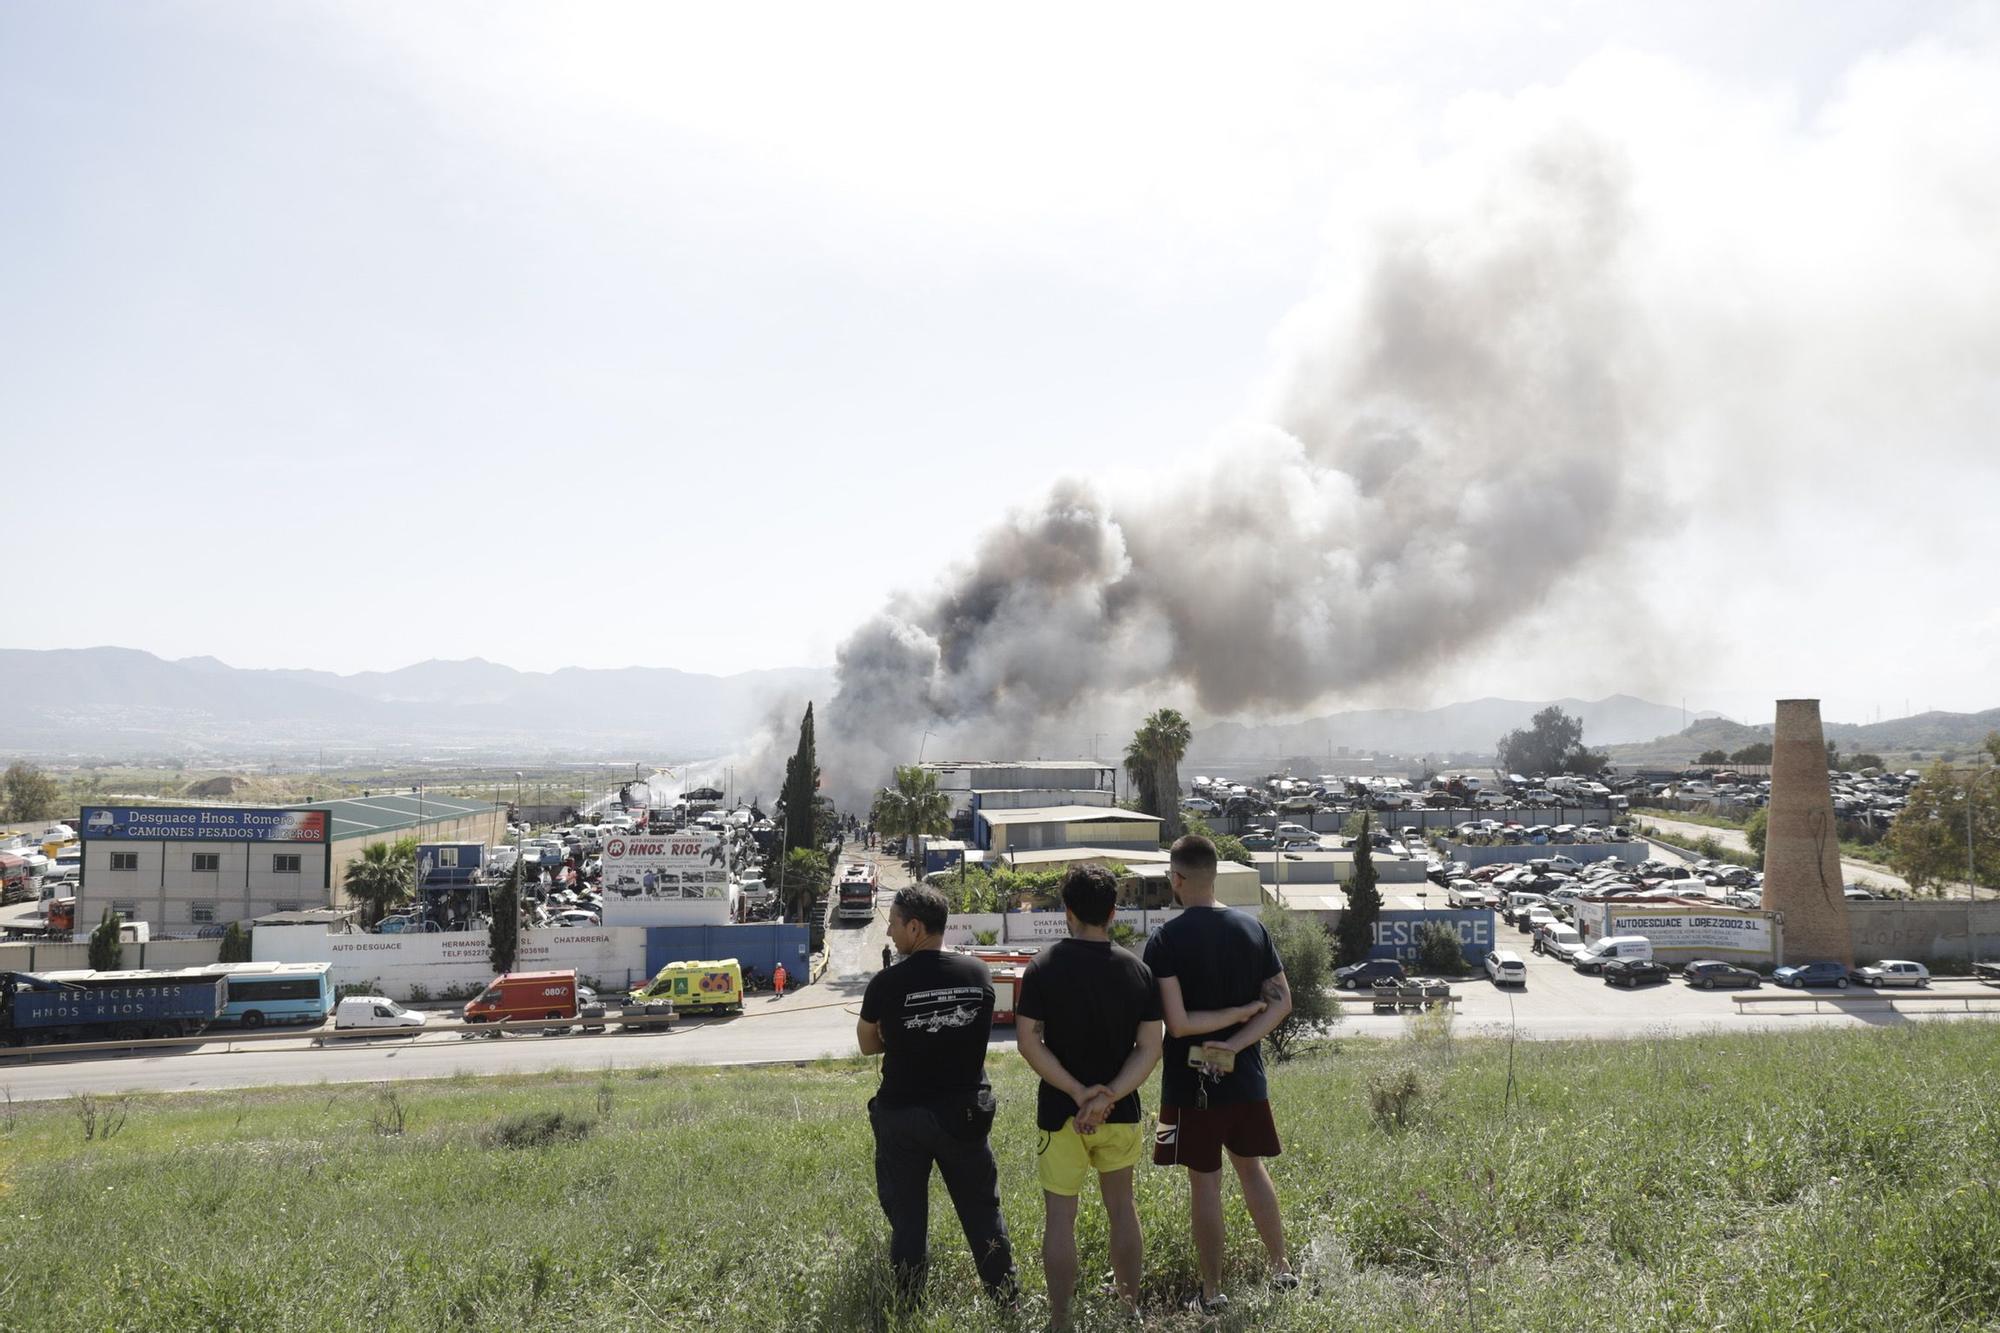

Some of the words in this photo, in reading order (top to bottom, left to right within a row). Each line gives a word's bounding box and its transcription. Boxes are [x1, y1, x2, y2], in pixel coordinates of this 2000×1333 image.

[128, 811, 196, 825] Desguace
[200, 812, 238, 824] Hnos.
[128, 826, 194, 837] CAMIONES
[198, 827, 253, 838] PESADOS
[257, 828, 265, 838] Y
[629, 843, 666, 856] HNOS.
[671, 843, 702, 856] RIOS
[442, 940, 486, 948] HERMANOS
[59, 986, 181, 1001] RECICLAJES
[544, 987, 561, 997] 080
[32, 1007, 80, 1019] HNOS
[97, 1003, 144, 1015] RIOS
